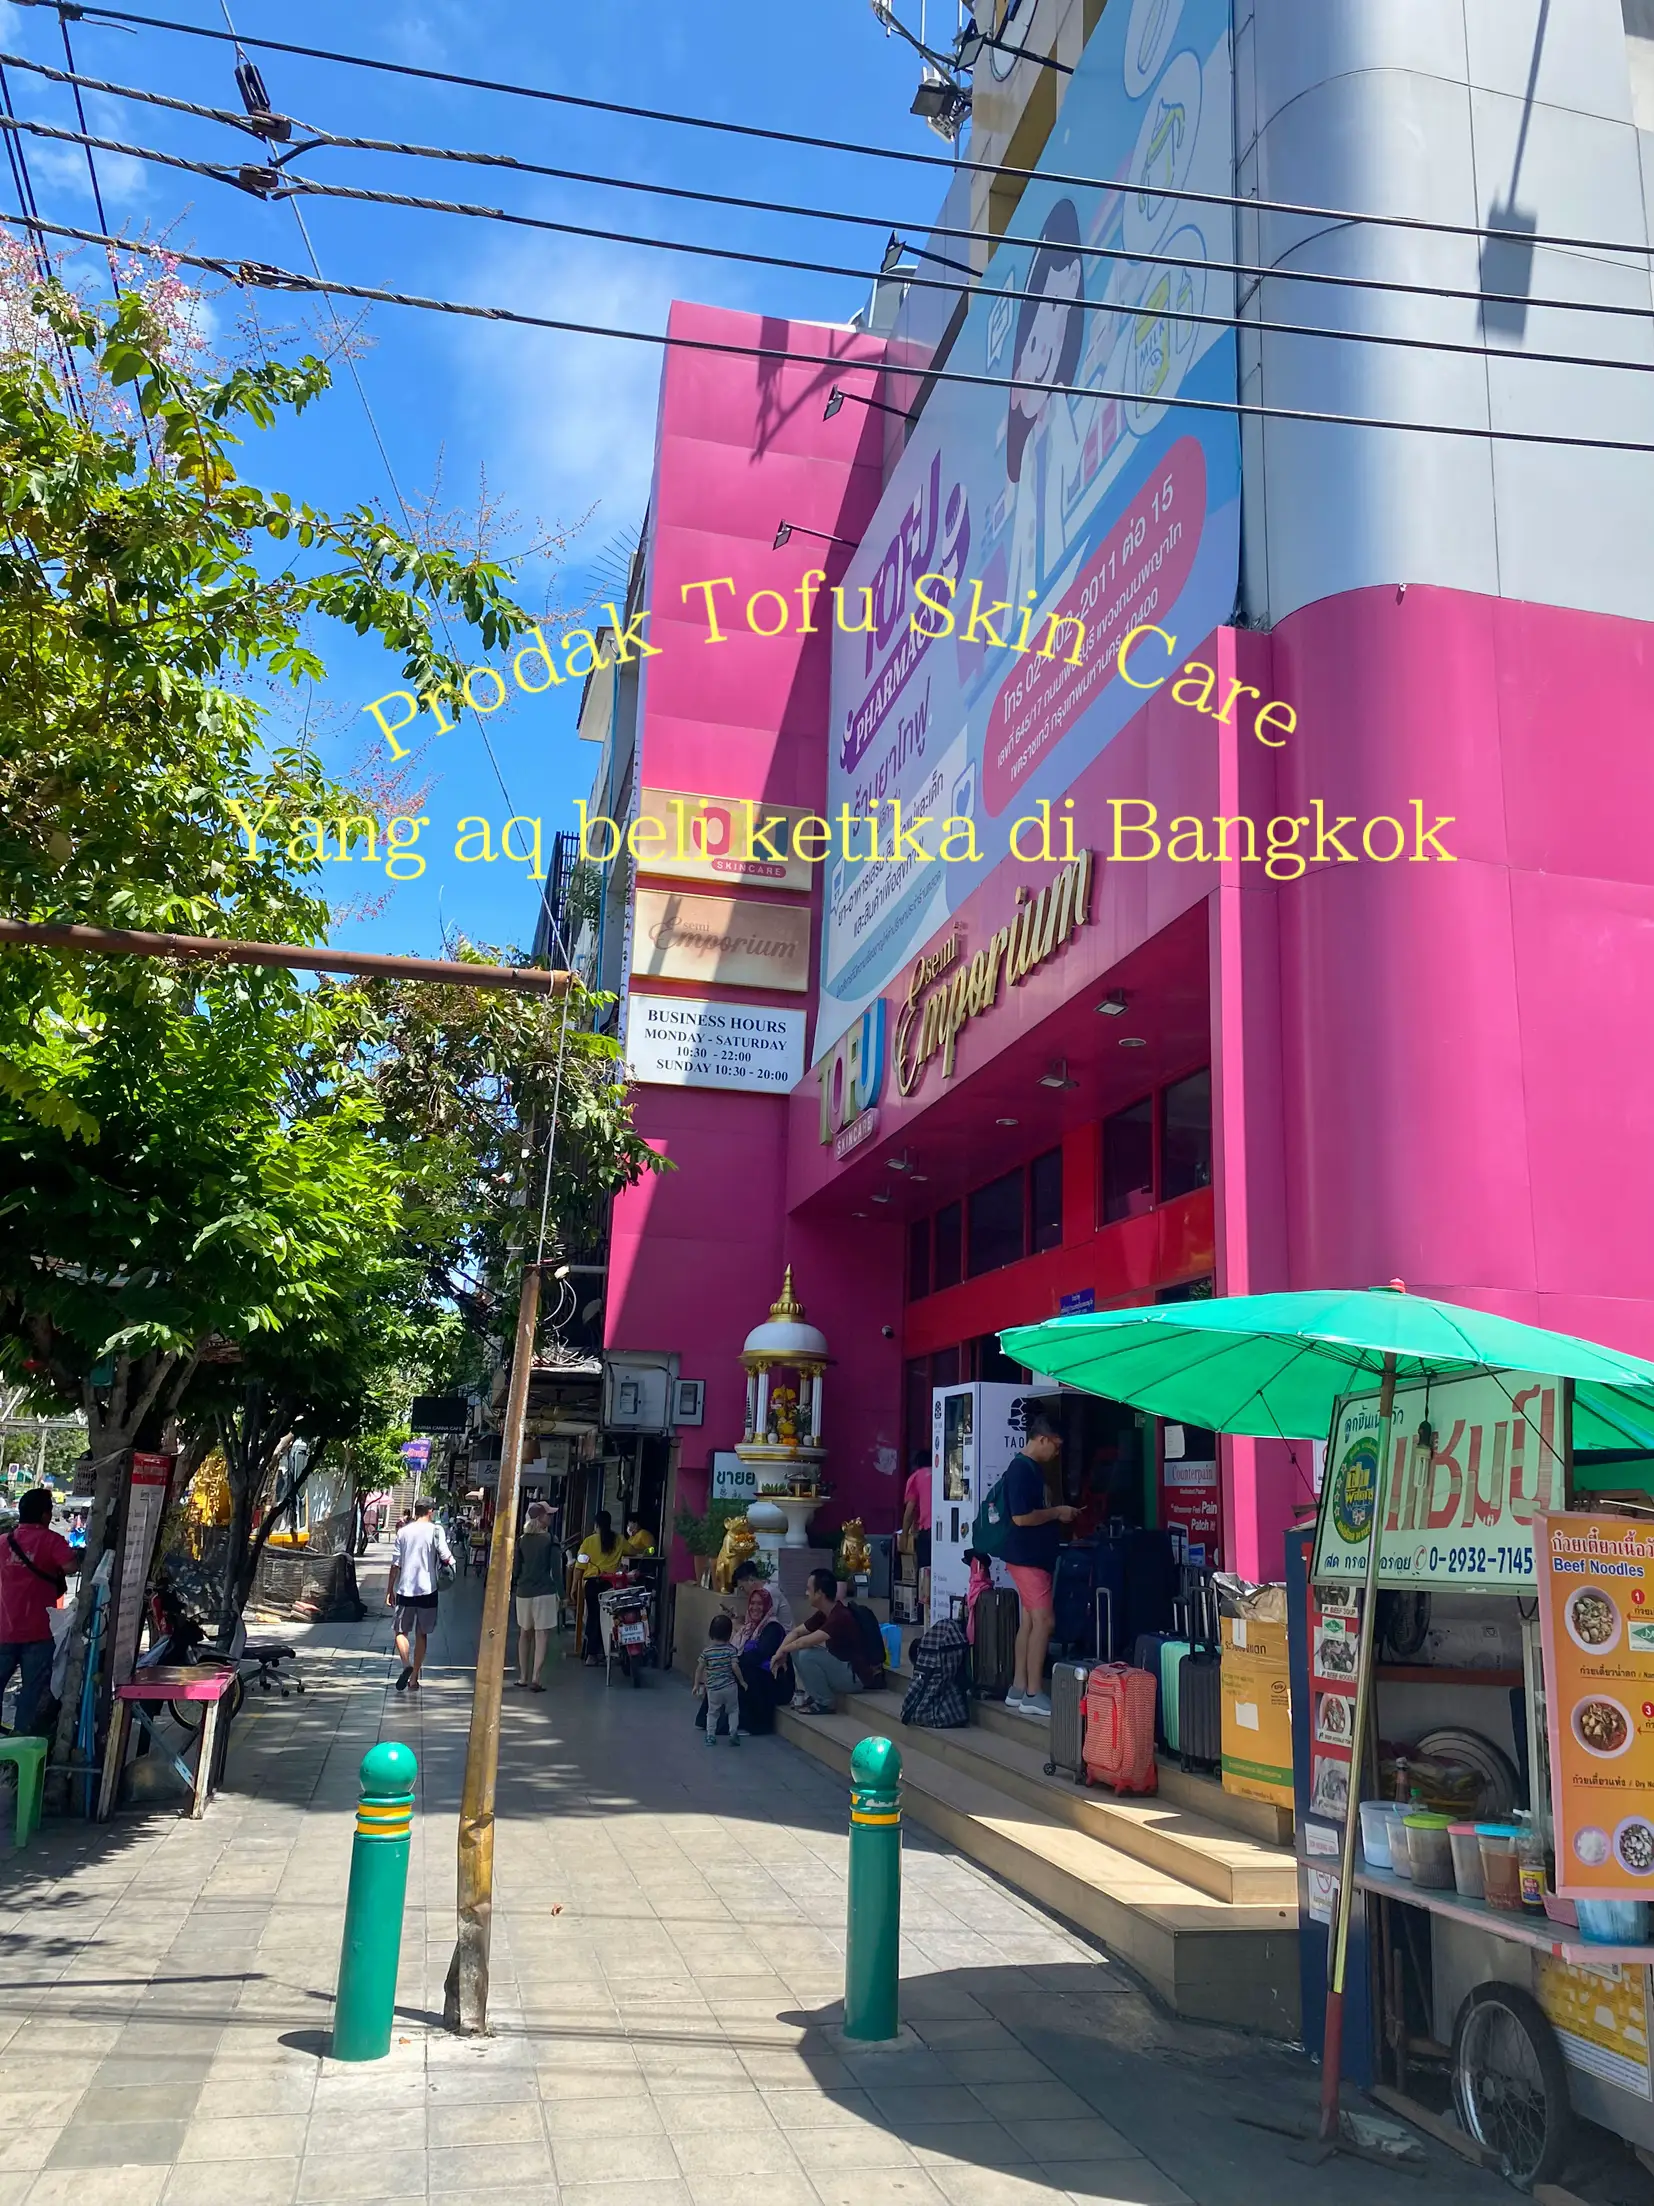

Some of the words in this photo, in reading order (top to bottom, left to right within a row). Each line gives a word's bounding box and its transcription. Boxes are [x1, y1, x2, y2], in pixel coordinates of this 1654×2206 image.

[1139, 320, 1165, 368] MILK
[1152, 473, 1175, 524] 15
[855, 586, 940, 755] PHARMACY
[716, 861, 781, 876] SKINCARE
[649, 916, 799, 959] Emporium
[894, 848, 1094, 1097] Emporium
[648, 1010, 726, 1028] BUSINESS
[730, 1017, 786, 1034] HOURS
[644, 1028, 706, 1044] MONDAY
[716, 1035, 788, 1051] SATURDAY
[677, 1046, 707, 1058] 10:30
[721, 1050, 751, 1062] 22:00
[656, 1059, 711, 1074] SUNDAY
[715, 1064, 746, 1077] 10:30
[757, 1069, 788, 1082] 20:00
[818, 997, 886, 1146] TOFU
[836, 1113, 873, 1157] SKINCARE
[1004, 1435, 1025, 1449] TAO
[484, 1465, 500, 1475] Be
[717, 1471, 756, 1486] ขายย
[1172, 1465, 1213, 1484] Counterpain
[1202, 1501, 1218, 1514] Pain
[1191, 1518, 1209, 1531] Patch
[1552, 1529, 1654, 1557] ก๋วยเตี๋ยวเนื้อวั
[1344, 1556, 1366, 1569] กรอ
[1380, 1552, 1411, 1570] อร่อย
[1430, 1546, 1534, 1574] 0-2932-7145
[1553, 1558, 1585, 1573] Beef
[1590, 1560, 1645, 1577] Noodles
[1330, 1606, 1342, 1614] BEEF
[1343, 1607, 1356, 1616] SOUP
